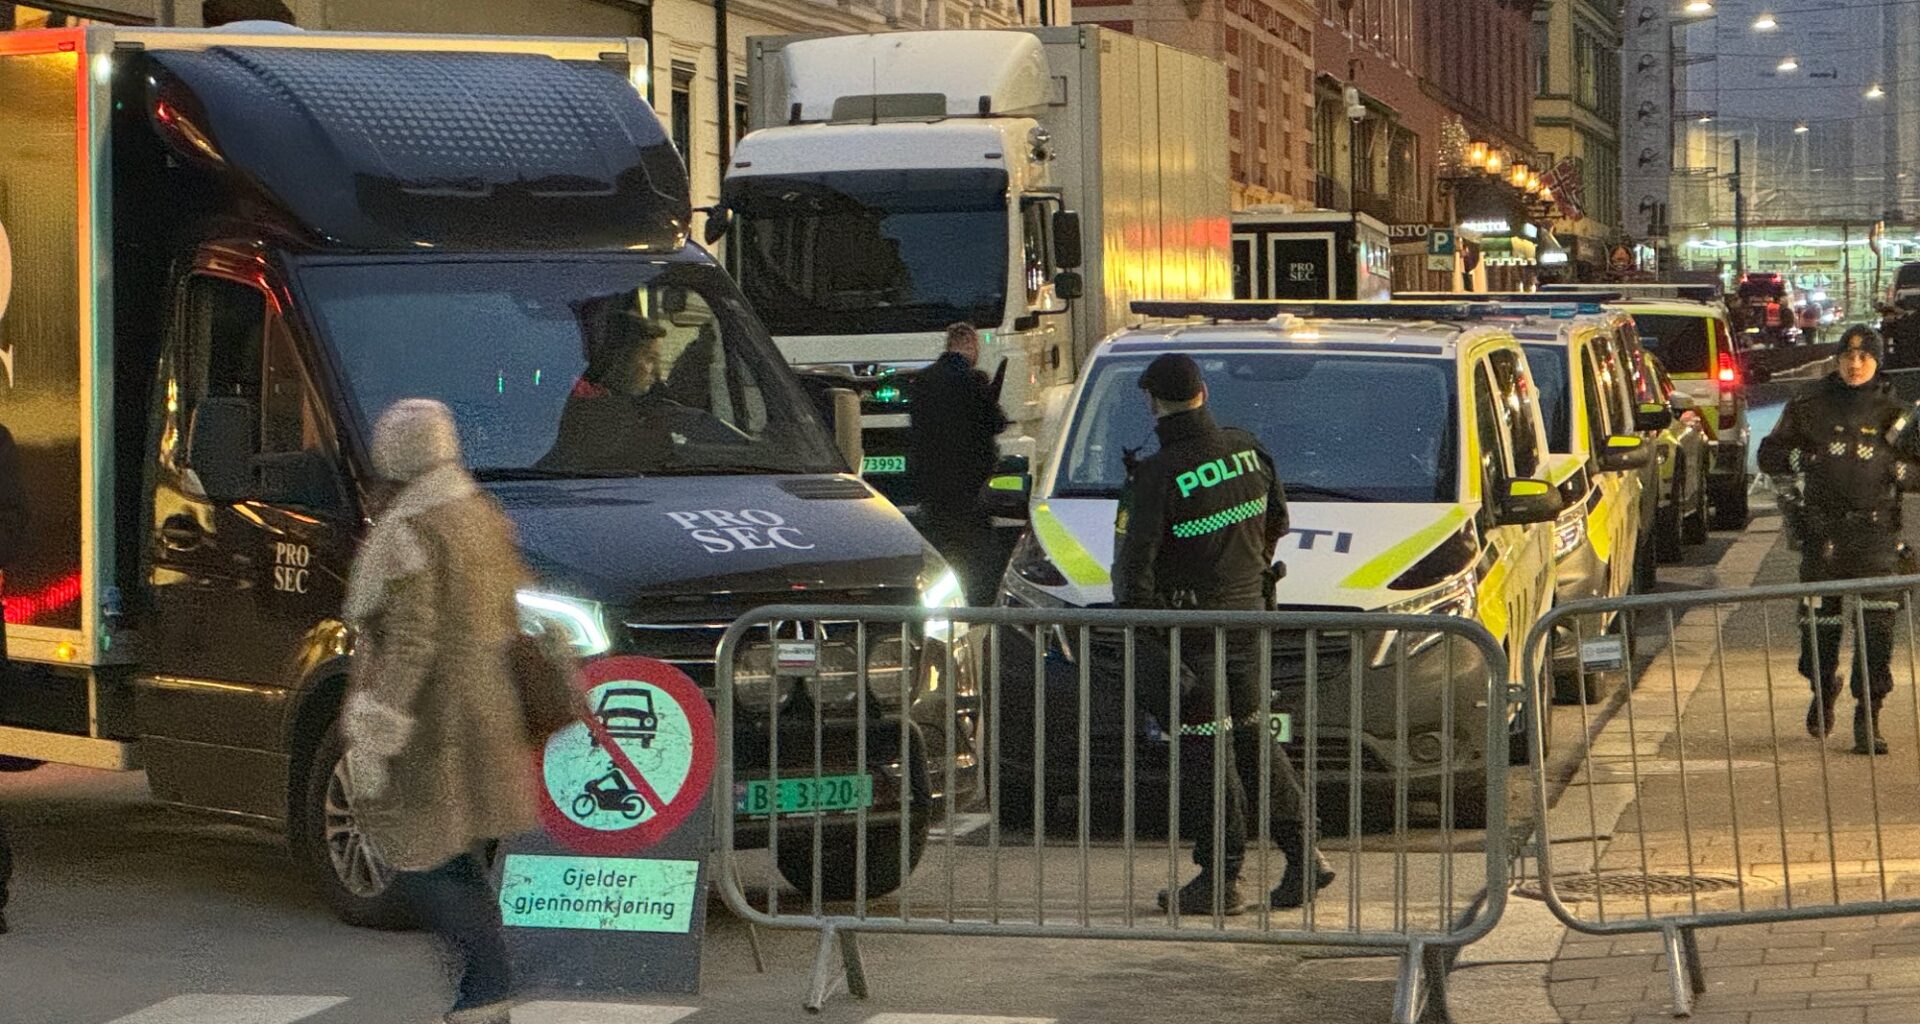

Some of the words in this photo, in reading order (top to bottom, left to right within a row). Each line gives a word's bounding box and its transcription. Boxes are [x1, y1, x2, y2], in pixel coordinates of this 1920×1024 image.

[1389, 223, 1434, 237] ISTO
[1434, 231, 1449, 252] P
[1289, 262, 1314, 271] PRO
[1289, 272, 1314, 282] SEC
[863, 458, 902, 470] 73992
[1175, 449, 1261, 498] POLITI
[664, 508, 785, 530] PRO
[691, 526, 816, 554] SEC
[275, 542, 309, 567] PRO
[273, 566, 309, 594] SEC
[563, 867, 638, 891] Gjelder
[514, 893, 676, 920] gjennomkjøring
